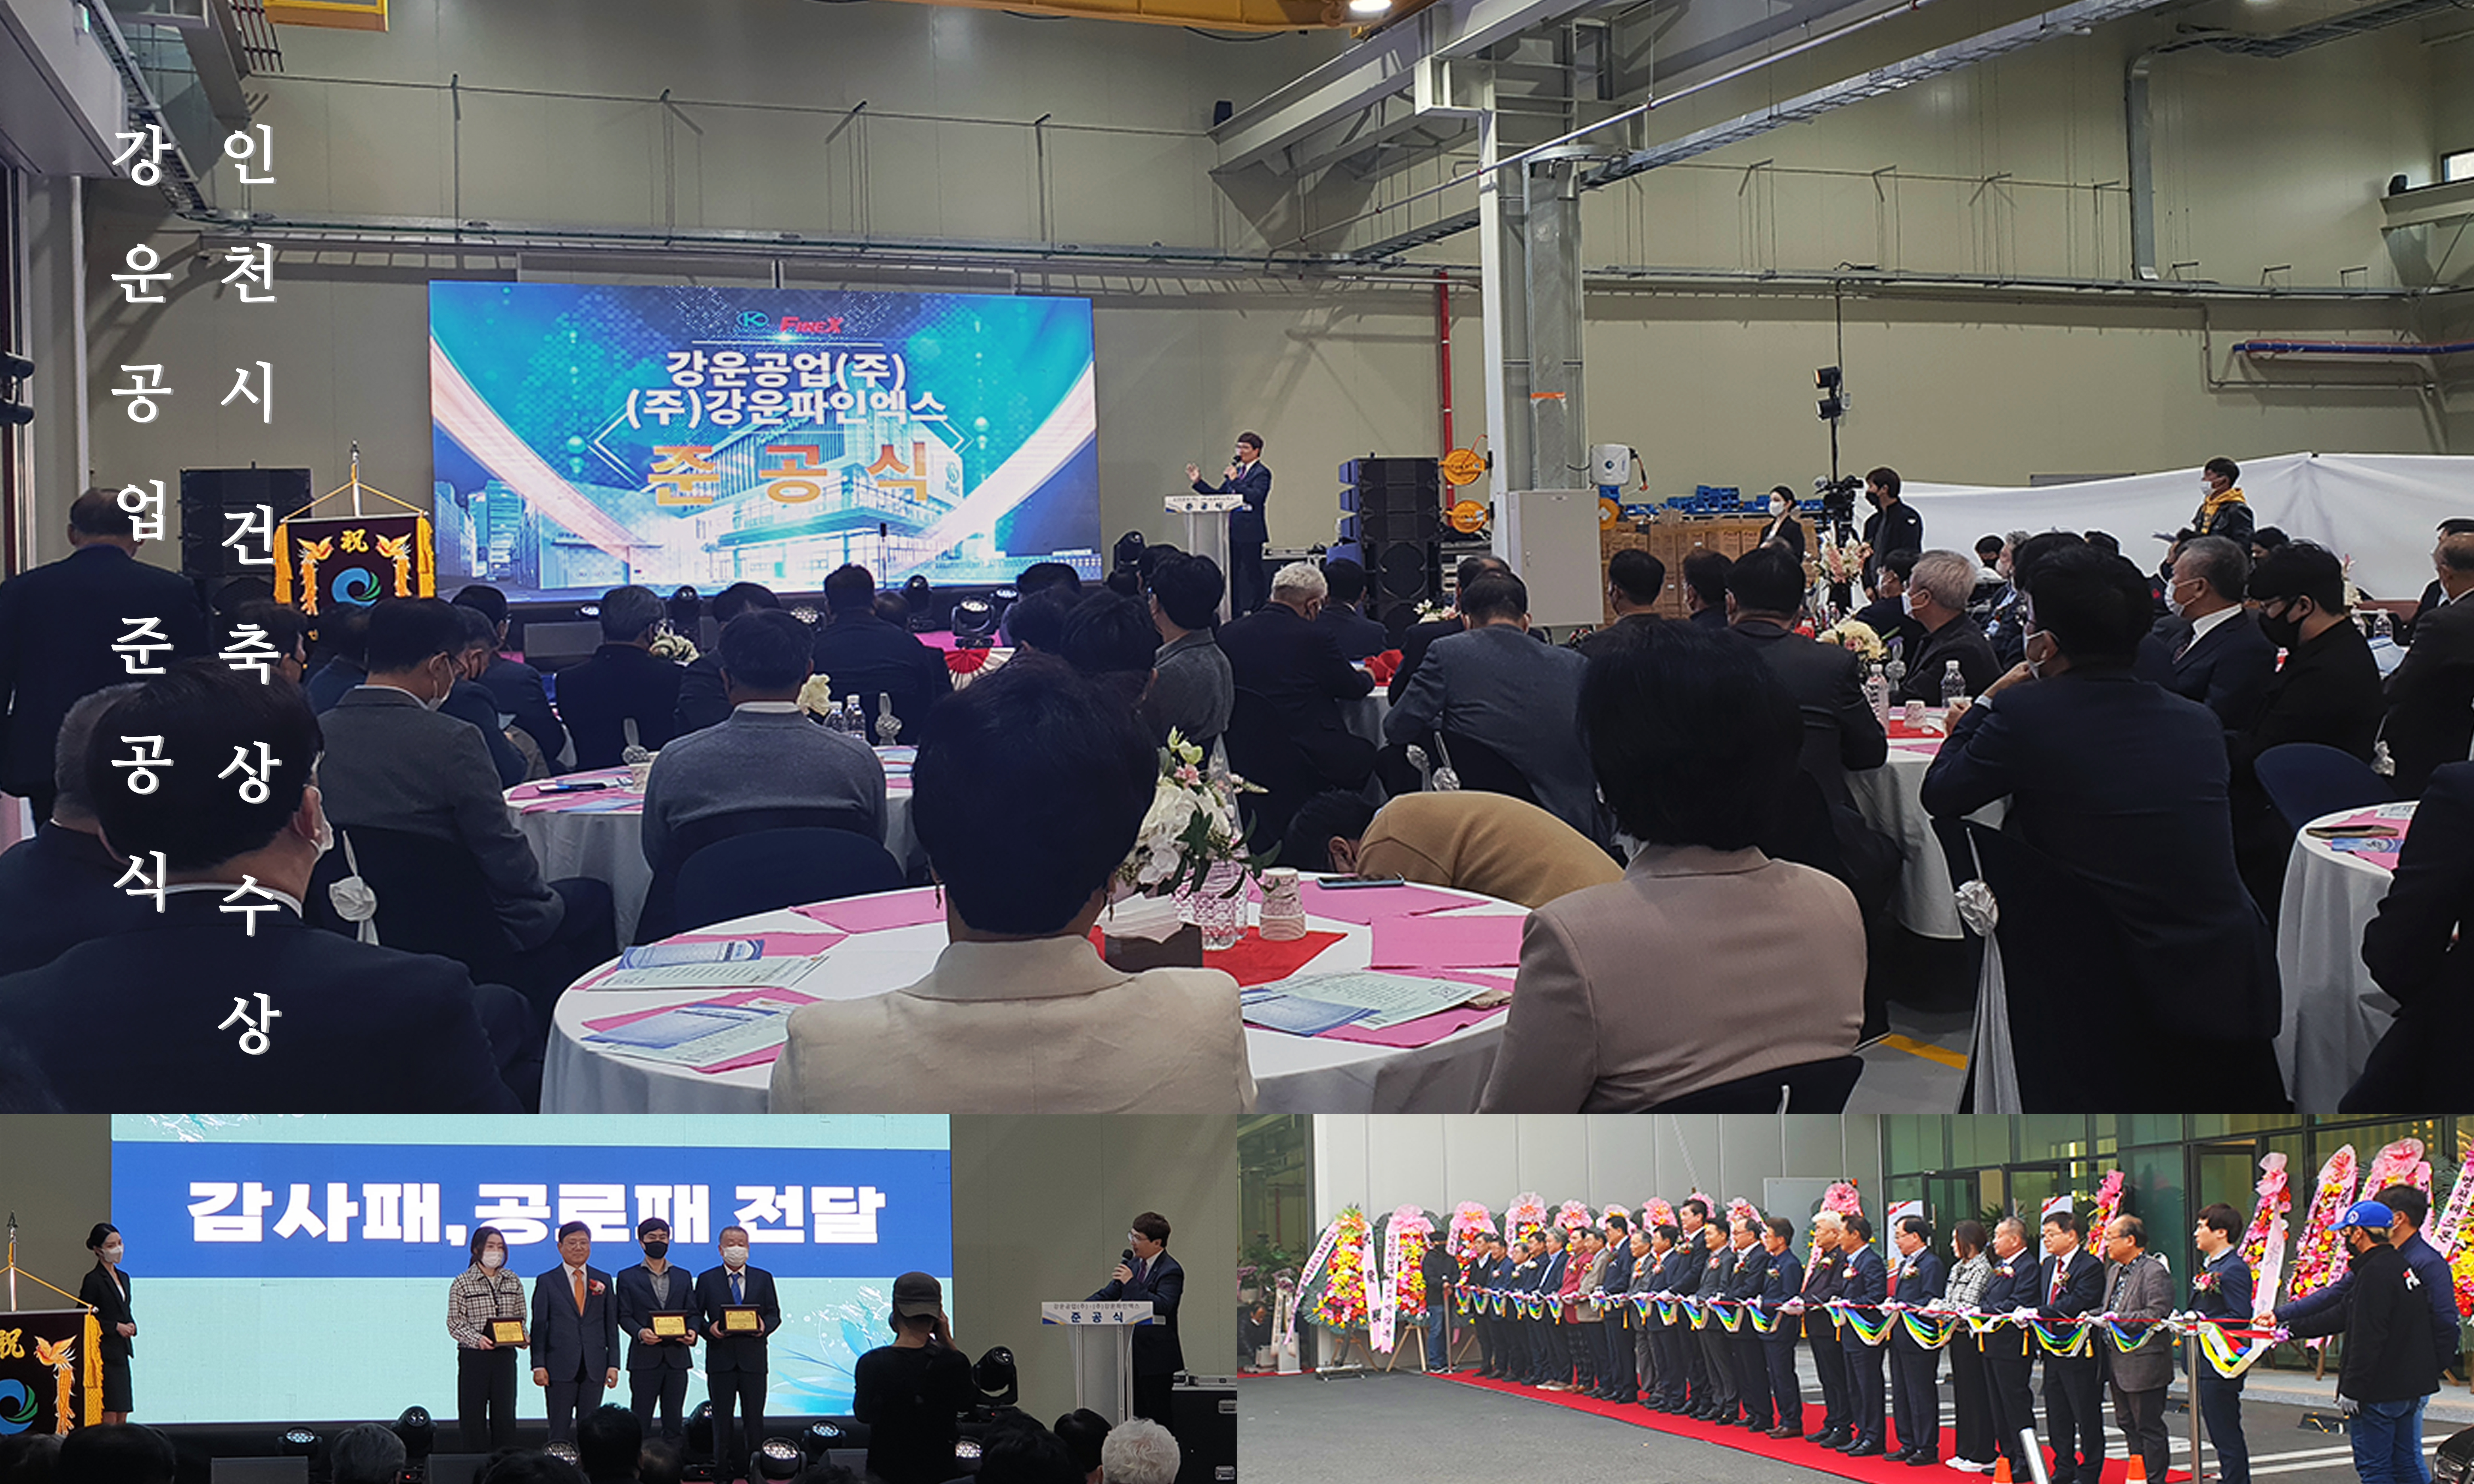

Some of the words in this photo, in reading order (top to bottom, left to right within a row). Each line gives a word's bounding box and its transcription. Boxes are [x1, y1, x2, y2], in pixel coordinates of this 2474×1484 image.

[666, 350, 905, 390] 강운공업(주)
[627, 388, 948, 428] (주)강운파인엑스
[733, 1184, 886, 1244] 전달
